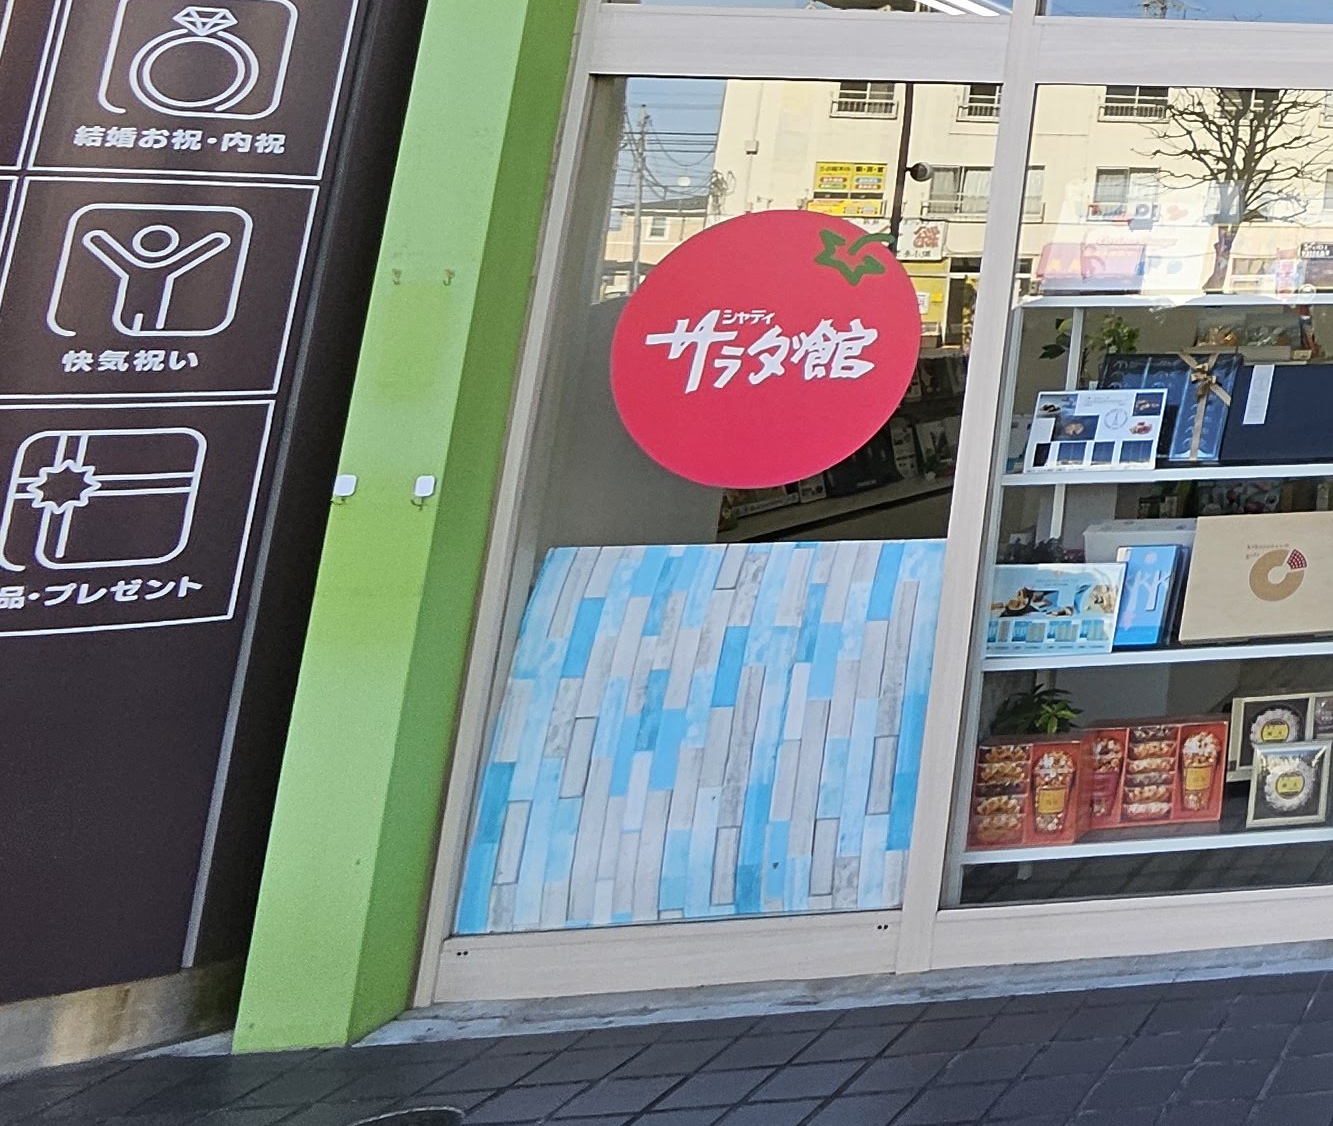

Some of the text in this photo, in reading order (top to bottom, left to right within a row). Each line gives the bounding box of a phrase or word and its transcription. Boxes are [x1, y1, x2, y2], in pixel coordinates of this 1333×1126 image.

[73, 126, 286, 154] 結婚お祝・内祝
[62, 350, 199, 374] 快気祝い
[645, 309, 878, 394] サラダ館
